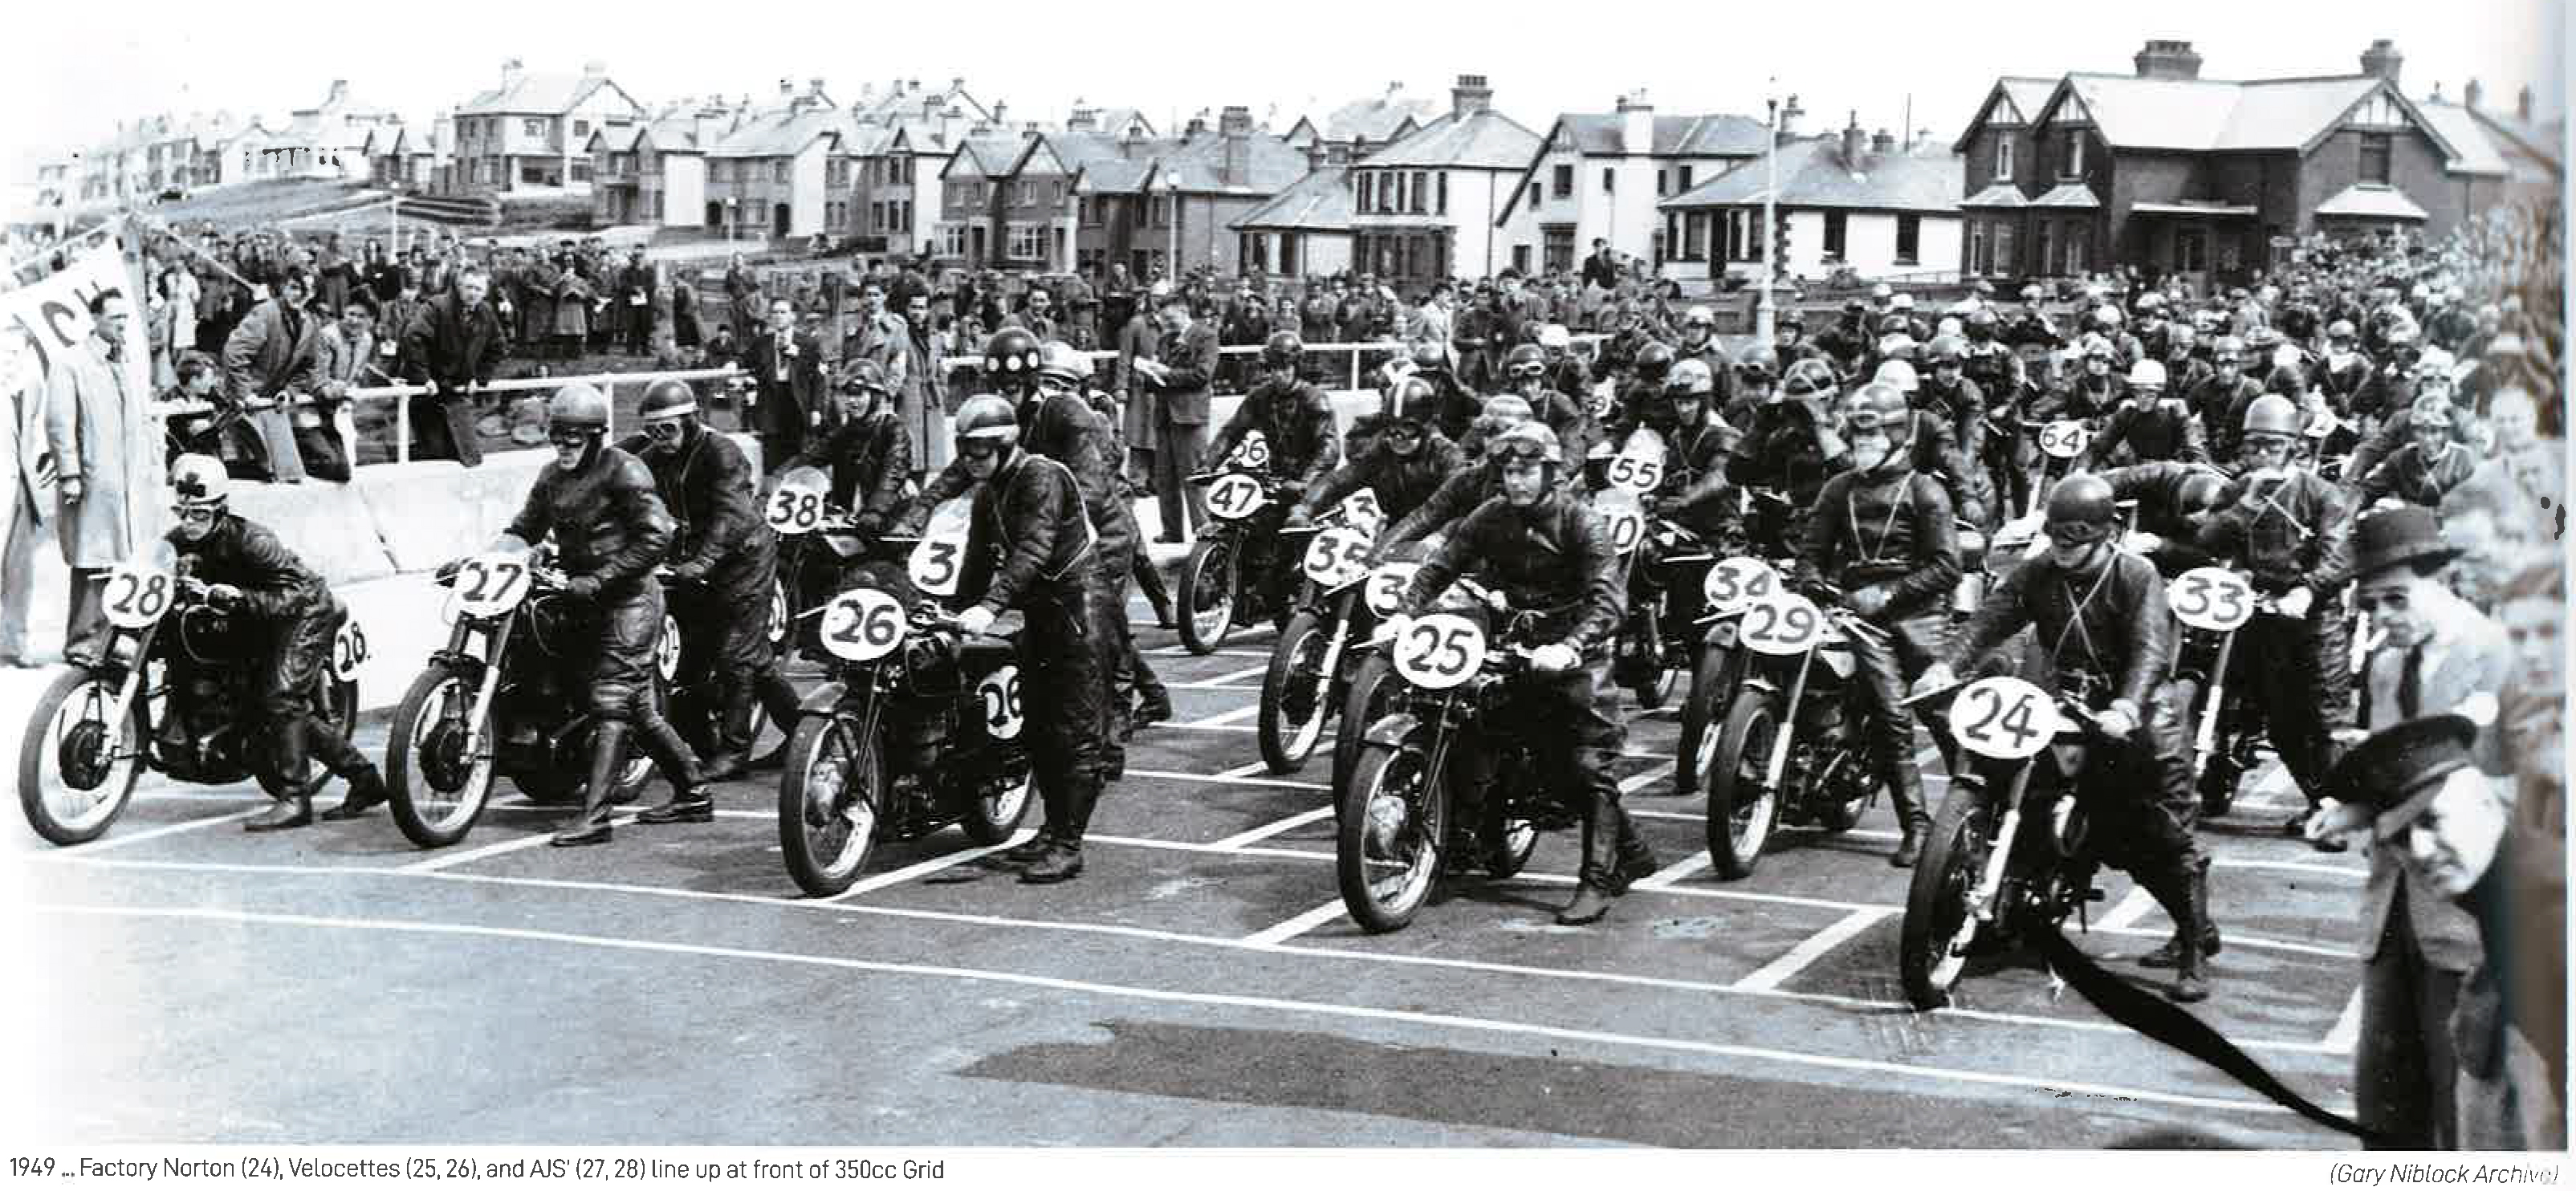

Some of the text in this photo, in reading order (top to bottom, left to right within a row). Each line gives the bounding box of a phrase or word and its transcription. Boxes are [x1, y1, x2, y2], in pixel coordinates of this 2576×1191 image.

[2043, 425, 2081, 453] 64
[1612, 458, 1657, 487] 55
[770, 490, 818, 527] 38
[1210, 482, 1257, 513] 47
[111, 572, 167, 616] 28
[462, 561, 523, 602] 27
[1710, 567, 1770, 601] 34
[2176, 575, 2245, 623] 33
[830, 600, 897, 645] 26
[1749, 604, 1815, 644] 29
[1407, 624, 1475, 675] 25
[1965, 687, 2039, 748] 24
